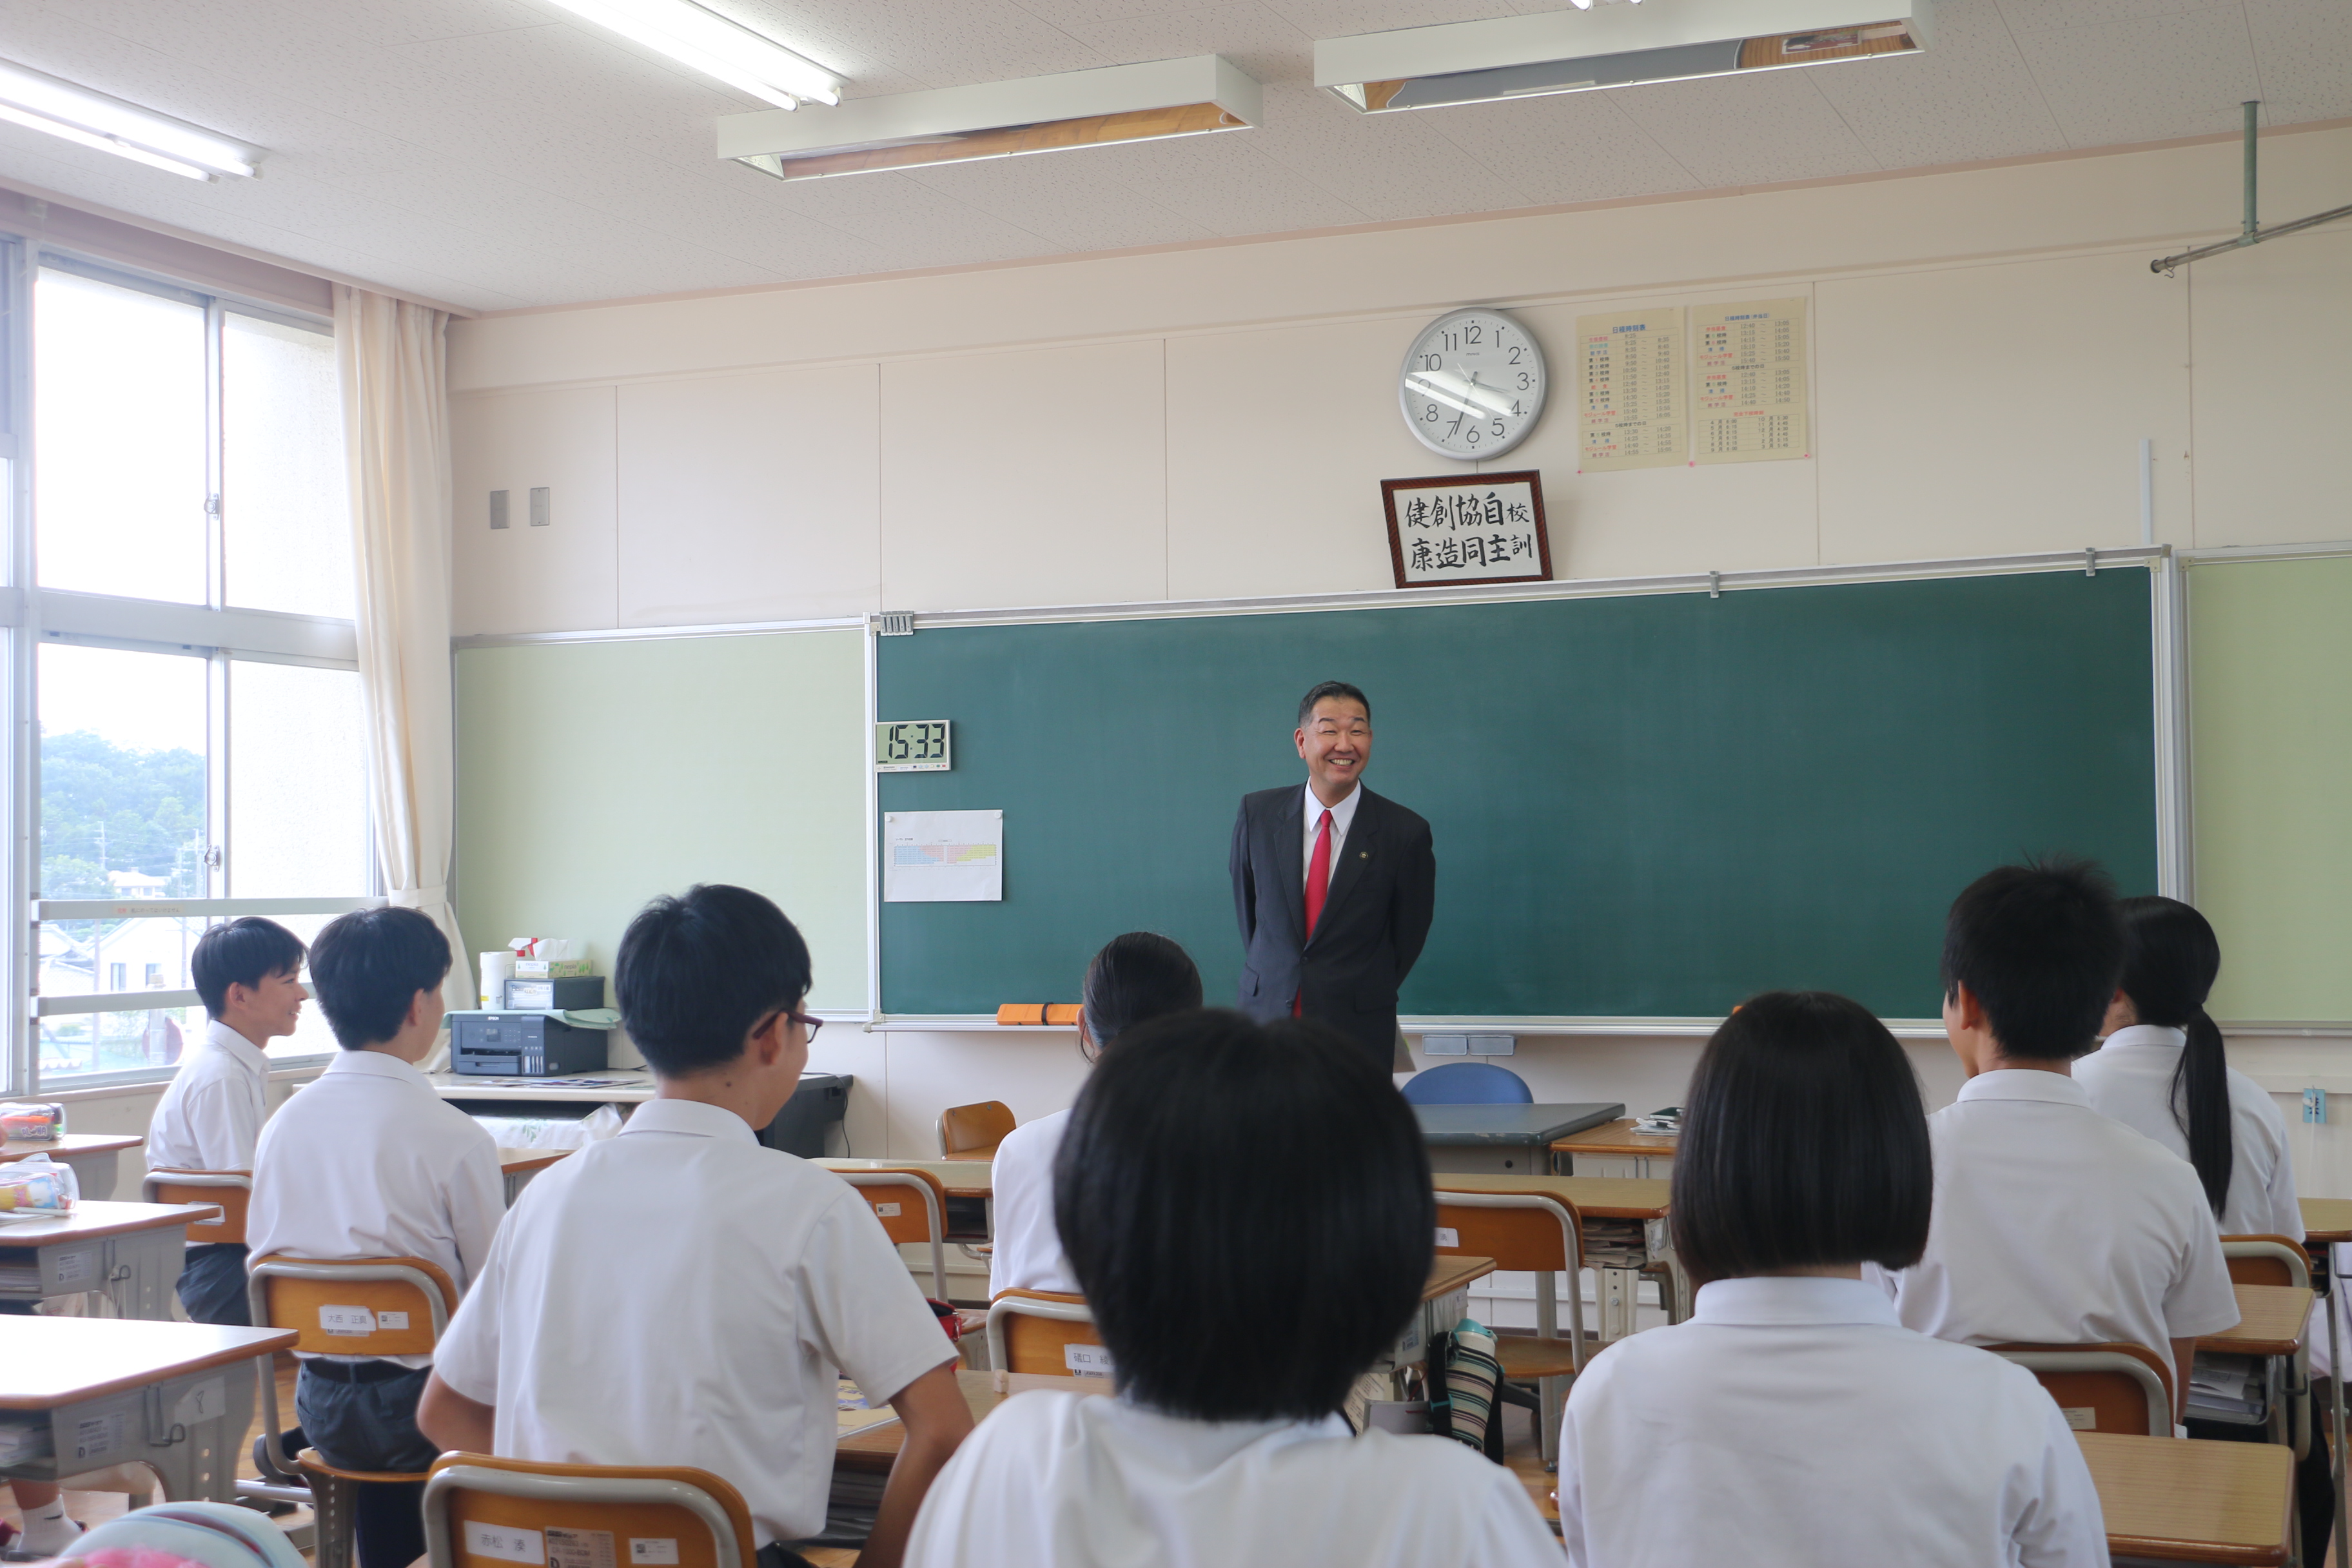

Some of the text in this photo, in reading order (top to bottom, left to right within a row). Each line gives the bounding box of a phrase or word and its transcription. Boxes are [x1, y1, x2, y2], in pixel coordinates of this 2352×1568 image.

[1464, 326, 1482, 344] 12
[1613, 324, 1645, 333] 日程時刻表
[1444, 333, 1456, 351] 11
[1495, 330, 1500, 348] 1
[1425, 354, 1442, 371] 10
[1509, 346, 1521, 364] 2
[1517, 372, 1529, 390] 3
[1426, 404, 1438, 422] 8
[1511, 399, 1522, 416] 4
[1446, 420, 1458, 439] 7
[1466, 425, 1480, 443] 6
[1491, 418, 1505, 436] 5
[1404, 497, 1433, 571] 健康
[1430, 495, 1466, 569] 創造
[1455, 493, 1487, 567] 協同
[1483, 491, 1511, 562] 自主
[1505, 503, 1533, 558] 校訓
[888, 724, 945, 759] 15:33
[328, 1314, 368, 1324] 大西 正真
[195, 1390, 204, 1414] 8
[481, 1534, 503, 1549] 赤松
